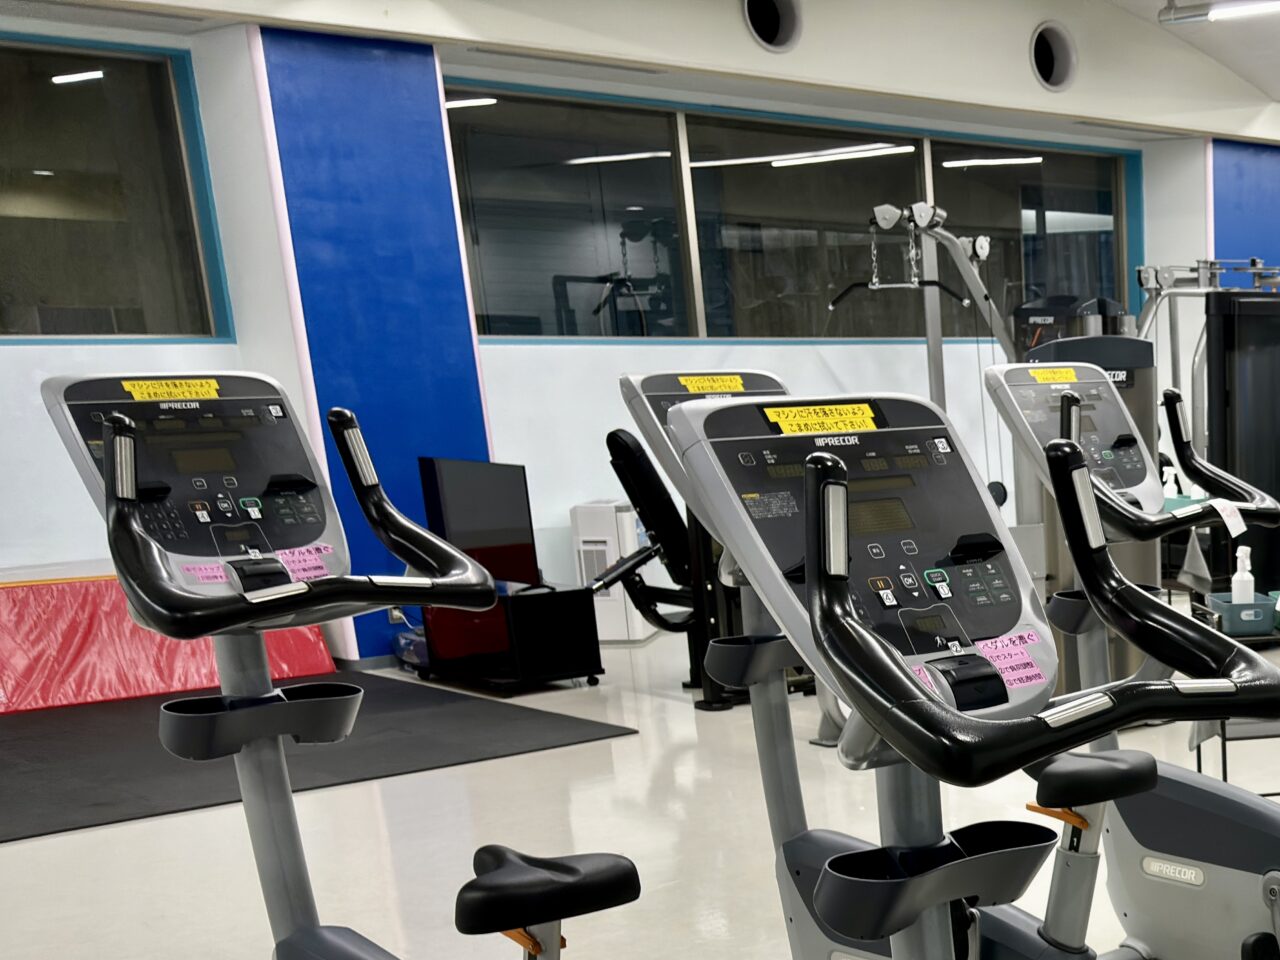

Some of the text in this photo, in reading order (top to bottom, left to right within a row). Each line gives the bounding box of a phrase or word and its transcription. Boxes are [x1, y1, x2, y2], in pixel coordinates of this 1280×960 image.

[165, 402, 201, 410] PRECOR
[820, 436, 861, 447] PRECOR
[904, 576, 915, 585] OK
[1157, 862, 1197, 881] PRECOR
